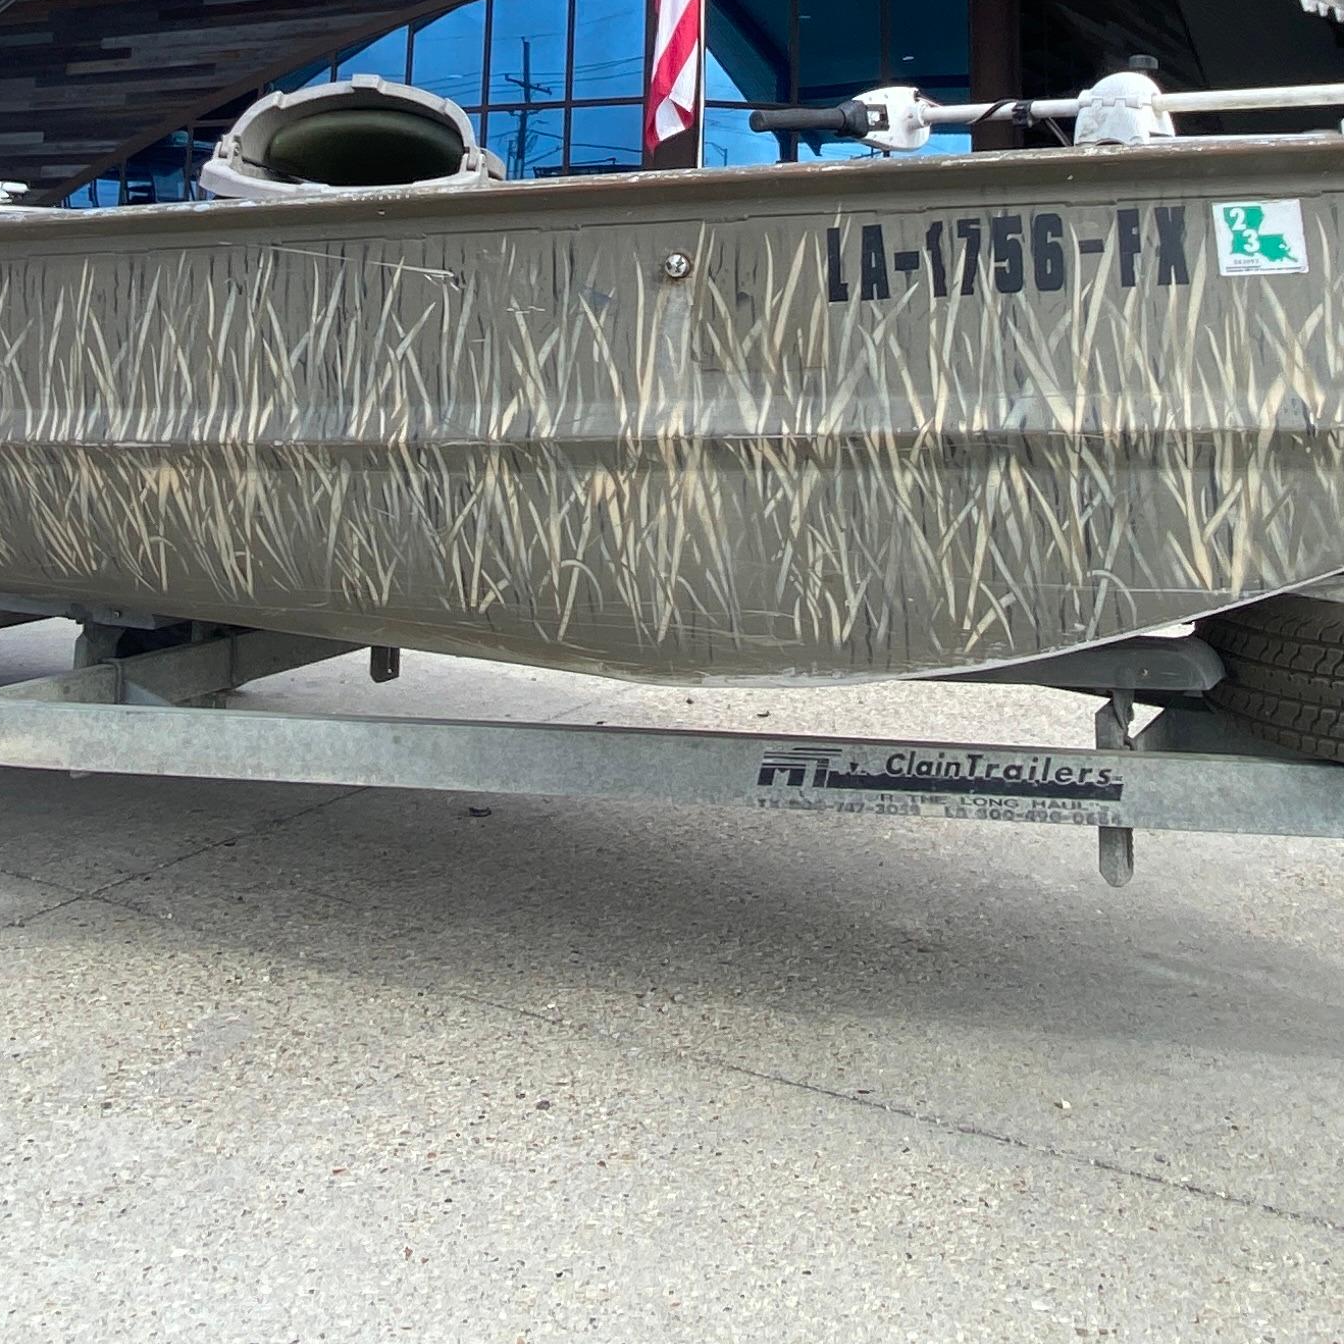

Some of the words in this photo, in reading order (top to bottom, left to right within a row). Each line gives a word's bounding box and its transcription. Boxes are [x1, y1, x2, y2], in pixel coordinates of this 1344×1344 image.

[1229, 208, 1247, 231] 2
[1242, 229, 1261, 253] 3
[910, 794, 947, 805] THE
[960, 797, 1019, 809] LONG
